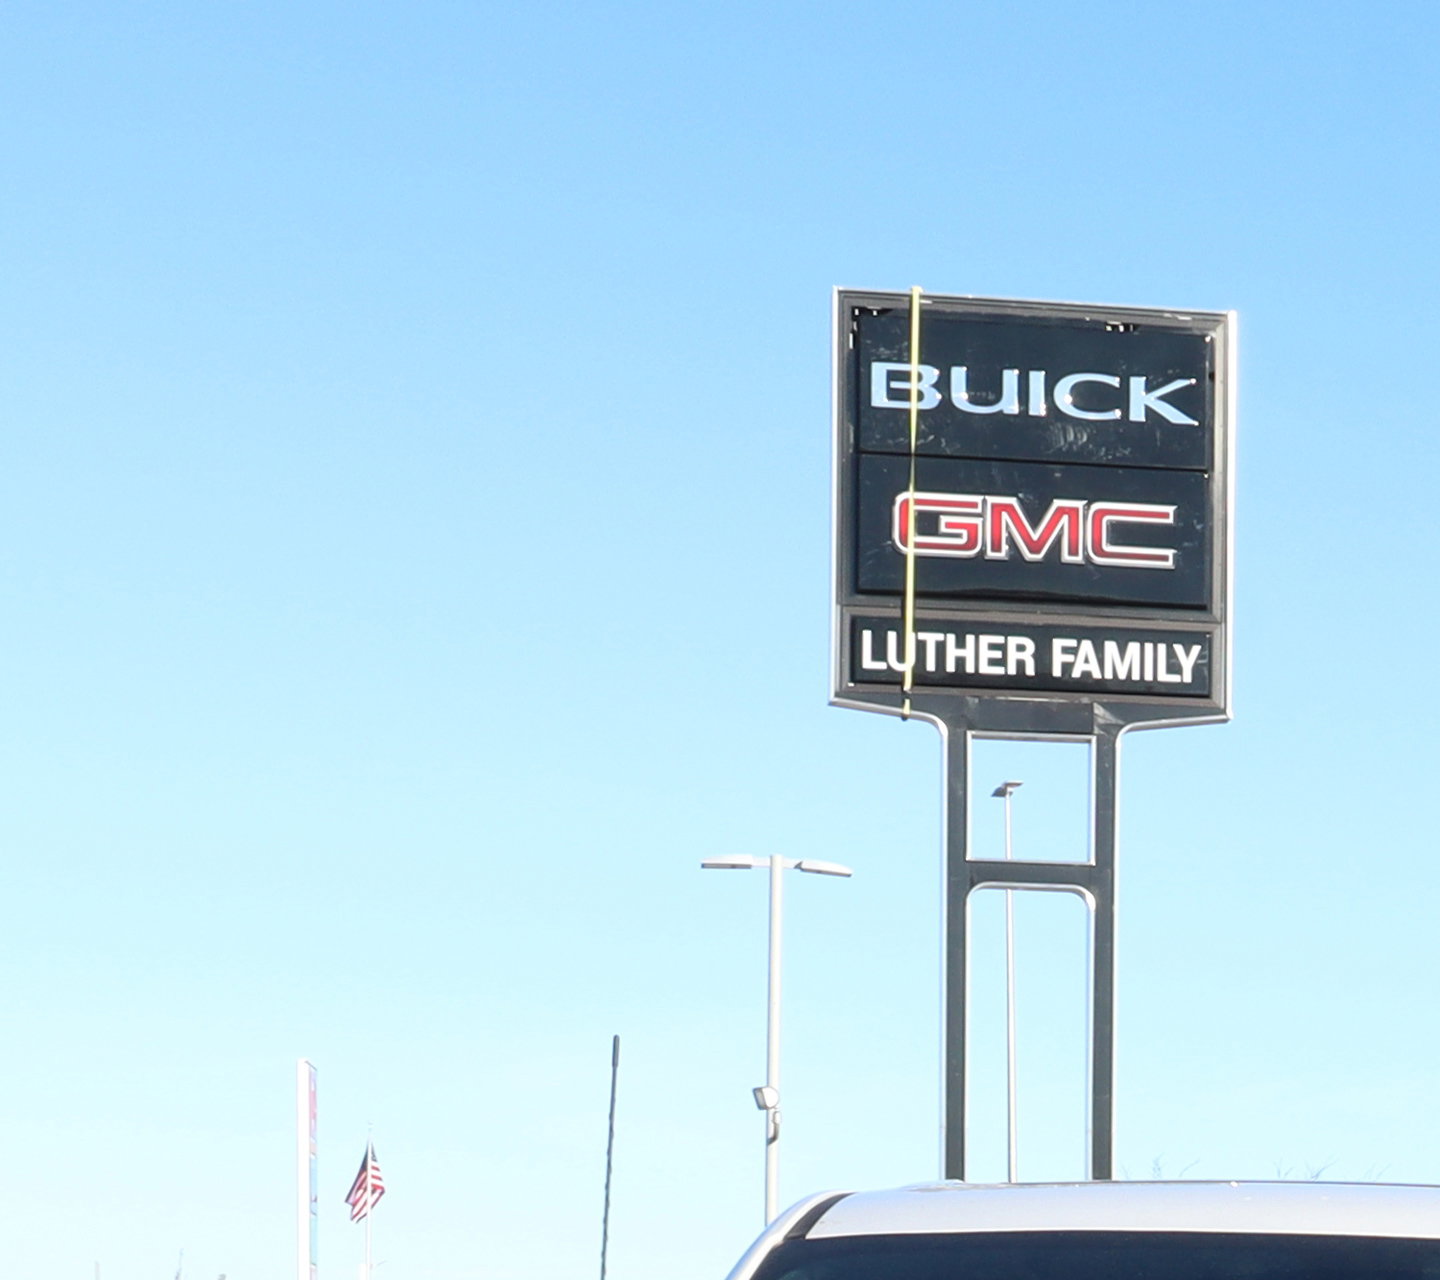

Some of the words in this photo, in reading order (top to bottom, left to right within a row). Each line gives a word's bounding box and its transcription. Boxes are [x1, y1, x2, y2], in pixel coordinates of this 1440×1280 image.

[870, 361, 1199, 425] BUICK
[892, 492, 1178, 569] GMC
[861, 629, 1035, 677] LUTHER
[1051, 638, 1201, 683] FAMILY
